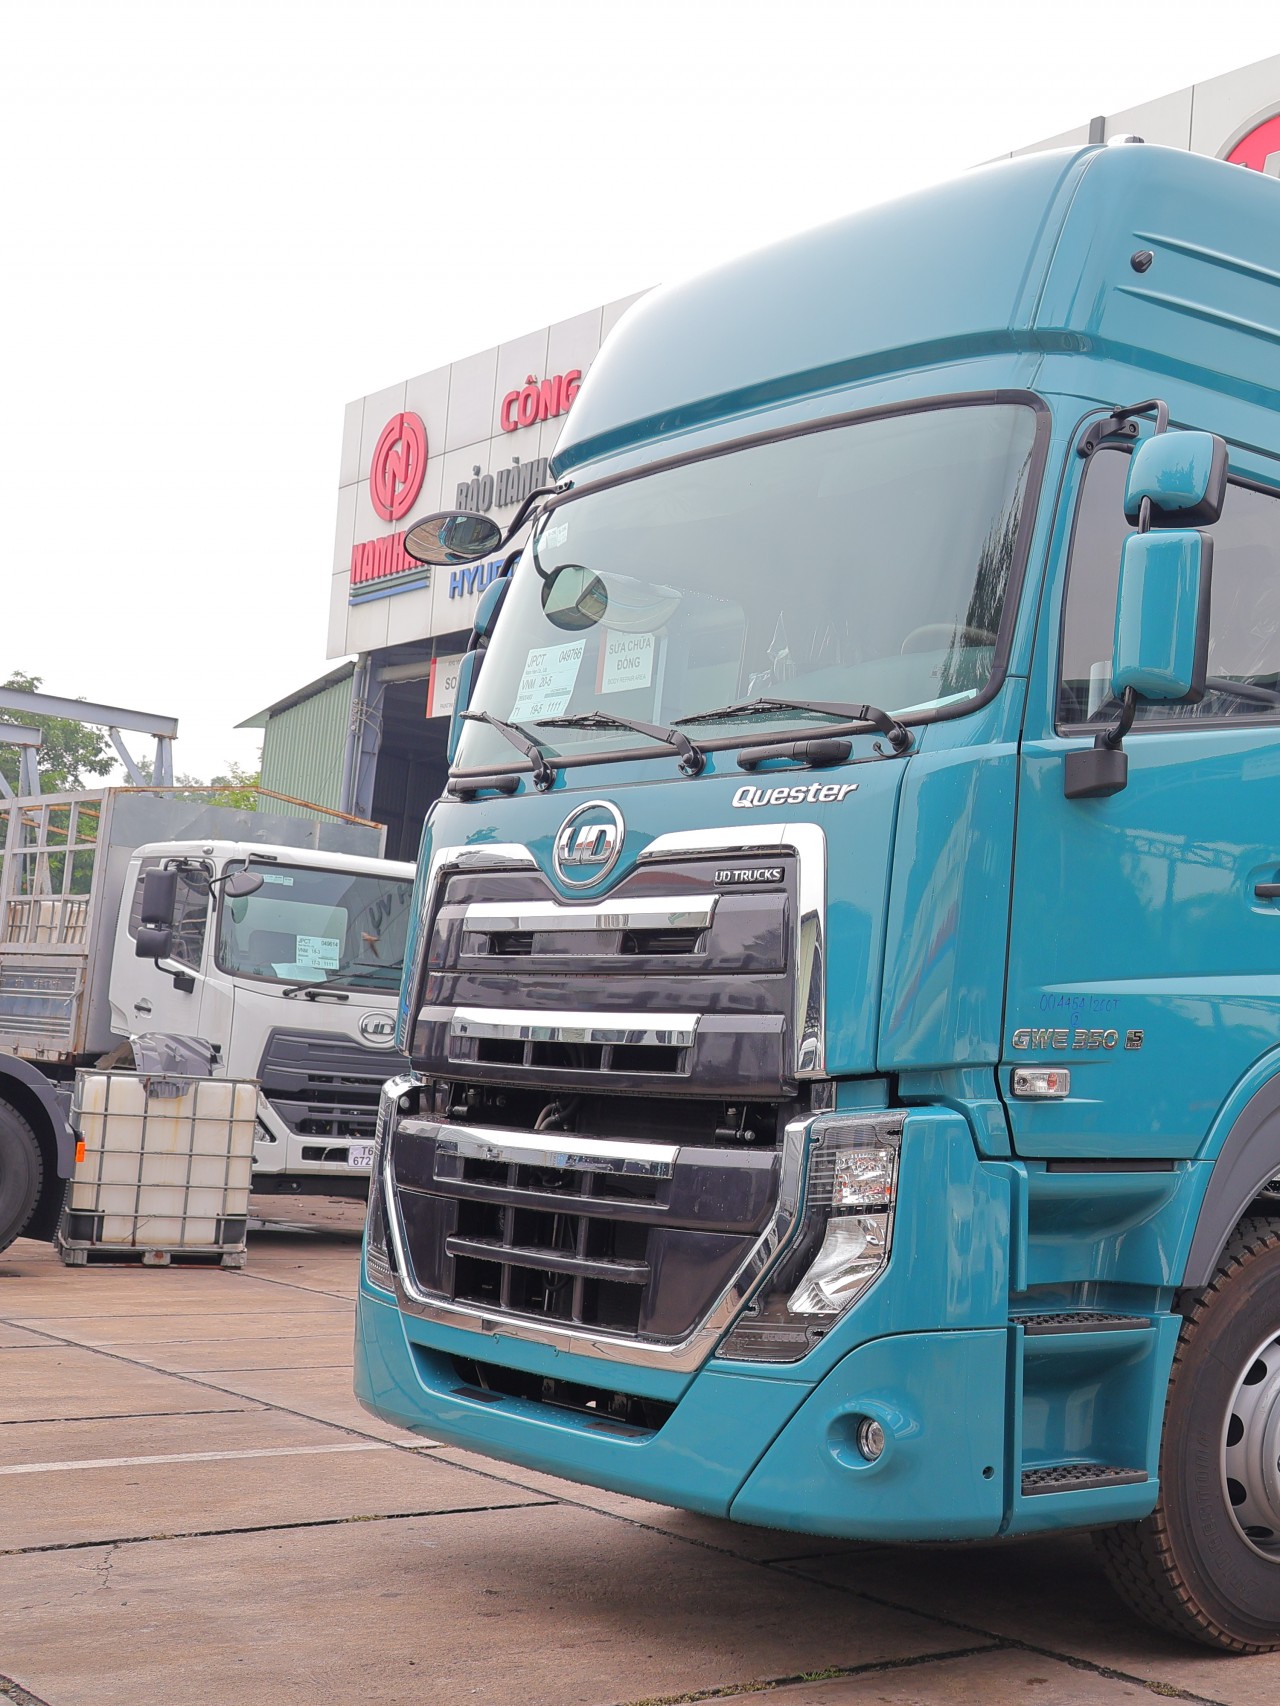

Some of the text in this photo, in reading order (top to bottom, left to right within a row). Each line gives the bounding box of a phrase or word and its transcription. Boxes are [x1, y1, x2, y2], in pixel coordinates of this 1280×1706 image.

[500, 369, 582, 432] CÔNG
[731, 782, 860, 809] Quester
[559, 824, 617, 865] UD
[715, 868, 781, 882] UD TRUCKS
[1012, 1028, 1069, 1050] GWE
[1071, 1028, 1119, 1050] 350
[353, 1156, 371, 1166] 672
[362, 1146, 374, 1156] T6
